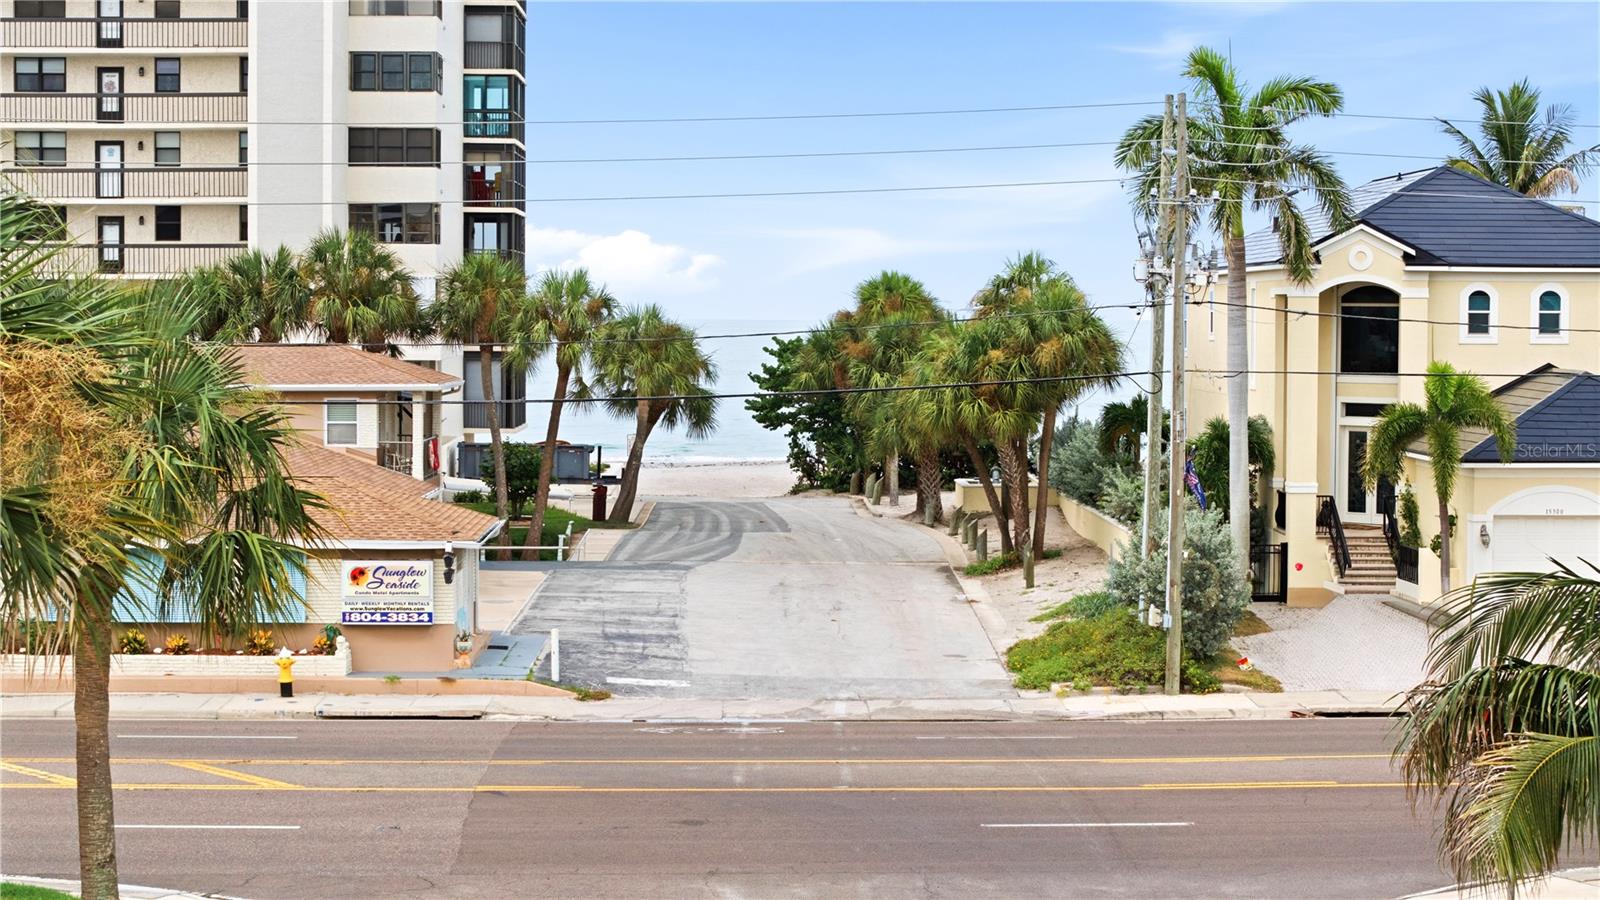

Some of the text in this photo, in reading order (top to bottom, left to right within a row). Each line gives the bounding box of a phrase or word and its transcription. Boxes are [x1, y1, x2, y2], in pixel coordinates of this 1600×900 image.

[370, 565, 427, 582] Sunglow
[366, 578, 421, 590] Seaside
[350, 612, 429, 622] 804-3834
